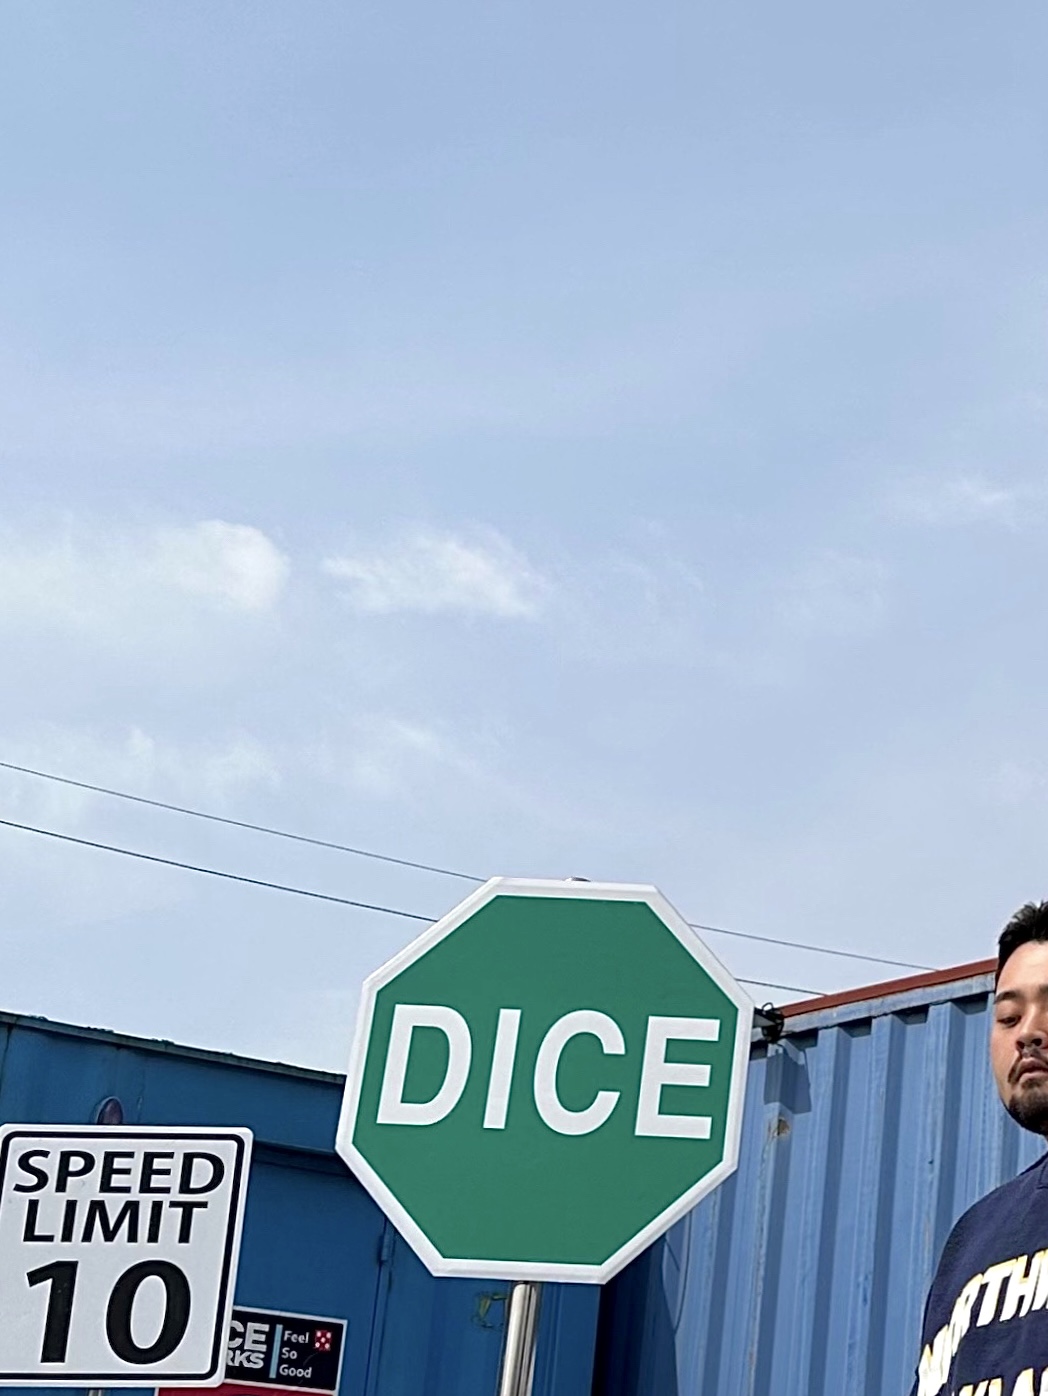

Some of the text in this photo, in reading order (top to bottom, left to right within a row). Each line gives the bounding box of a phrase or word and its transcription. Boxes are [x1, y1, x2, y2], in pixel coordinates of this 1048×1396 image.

[376, 1003, 721, 1140] DICE
[13, 1149, 225, 1195] SPEED
[22, 1199, 208, 1243] LIMIT
[26, 1259, 192, 1365] 10
[281, 1347, 298, 1359] So
[283, 1330, 310, 1344] Feel
[279, 1364, 313, 1378] Good
